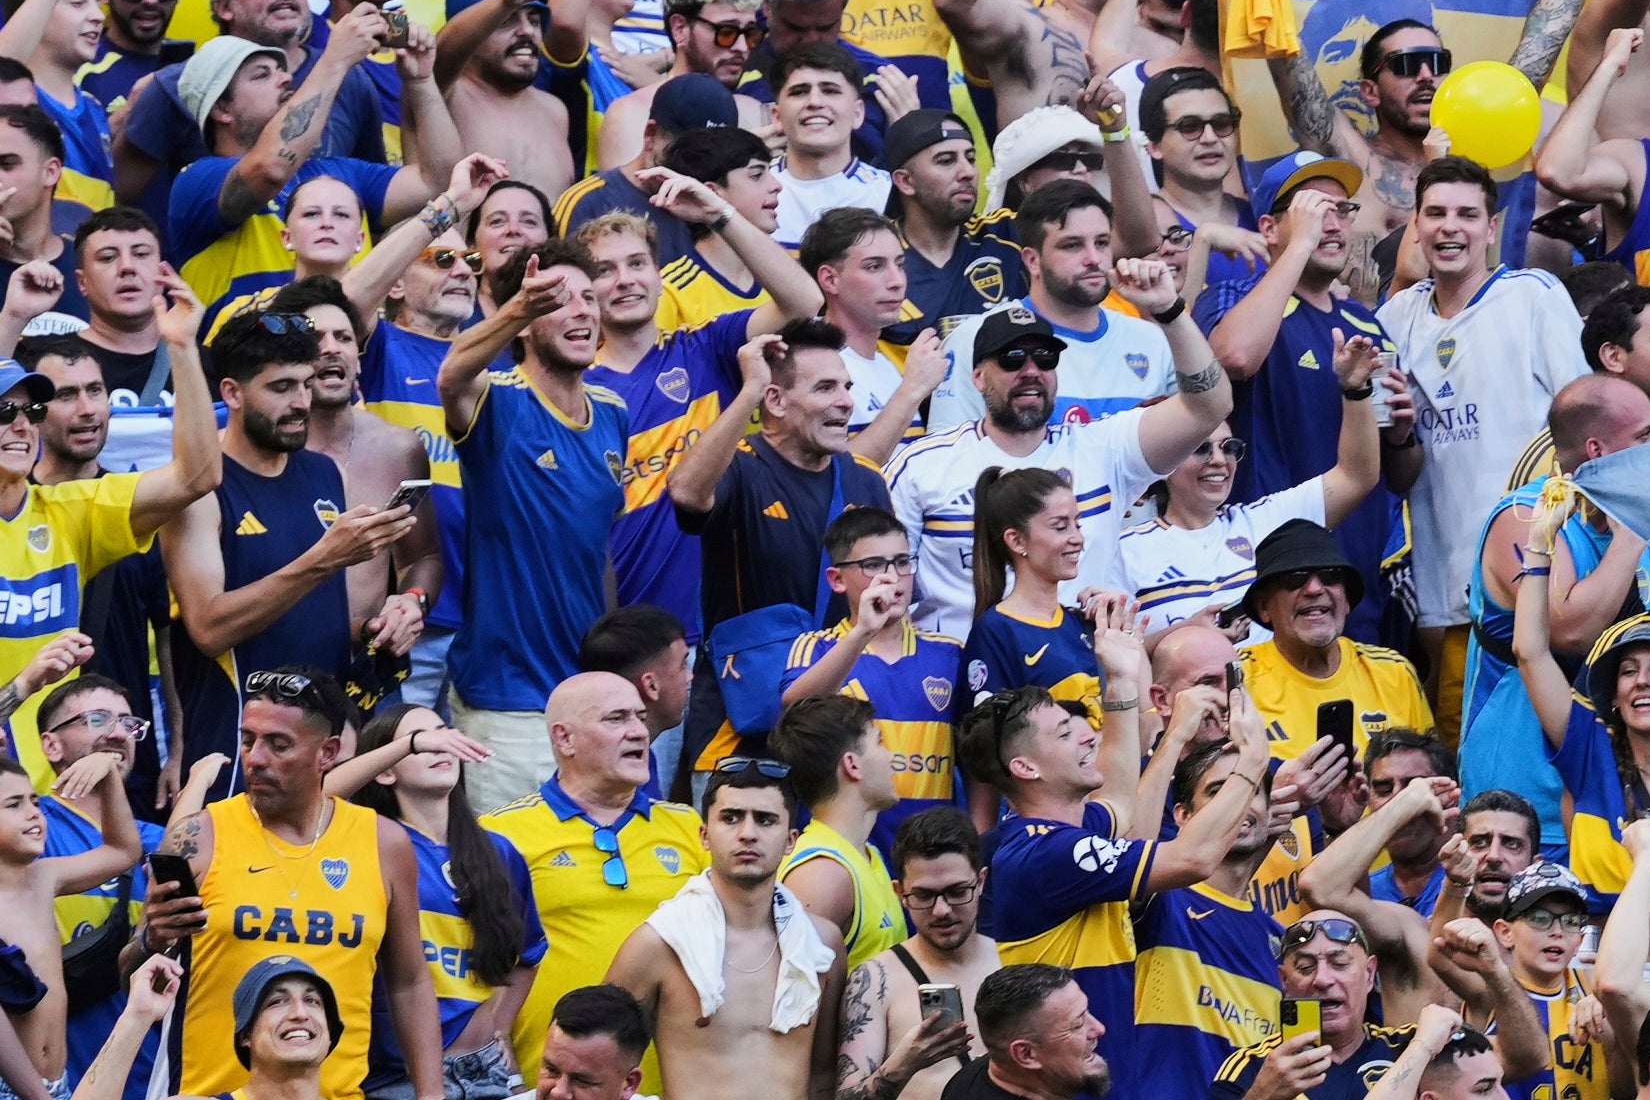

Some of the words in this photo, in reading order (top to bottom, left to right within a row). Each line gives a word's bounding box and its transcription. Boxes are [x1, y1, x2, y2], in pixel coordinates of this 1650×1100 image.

[840, 1, 924, 36] QATAR
[0, 582, 64, 625] EPSI
[890, 753, 952, 776] sson
[232, 904, 364, 950] CABJ
